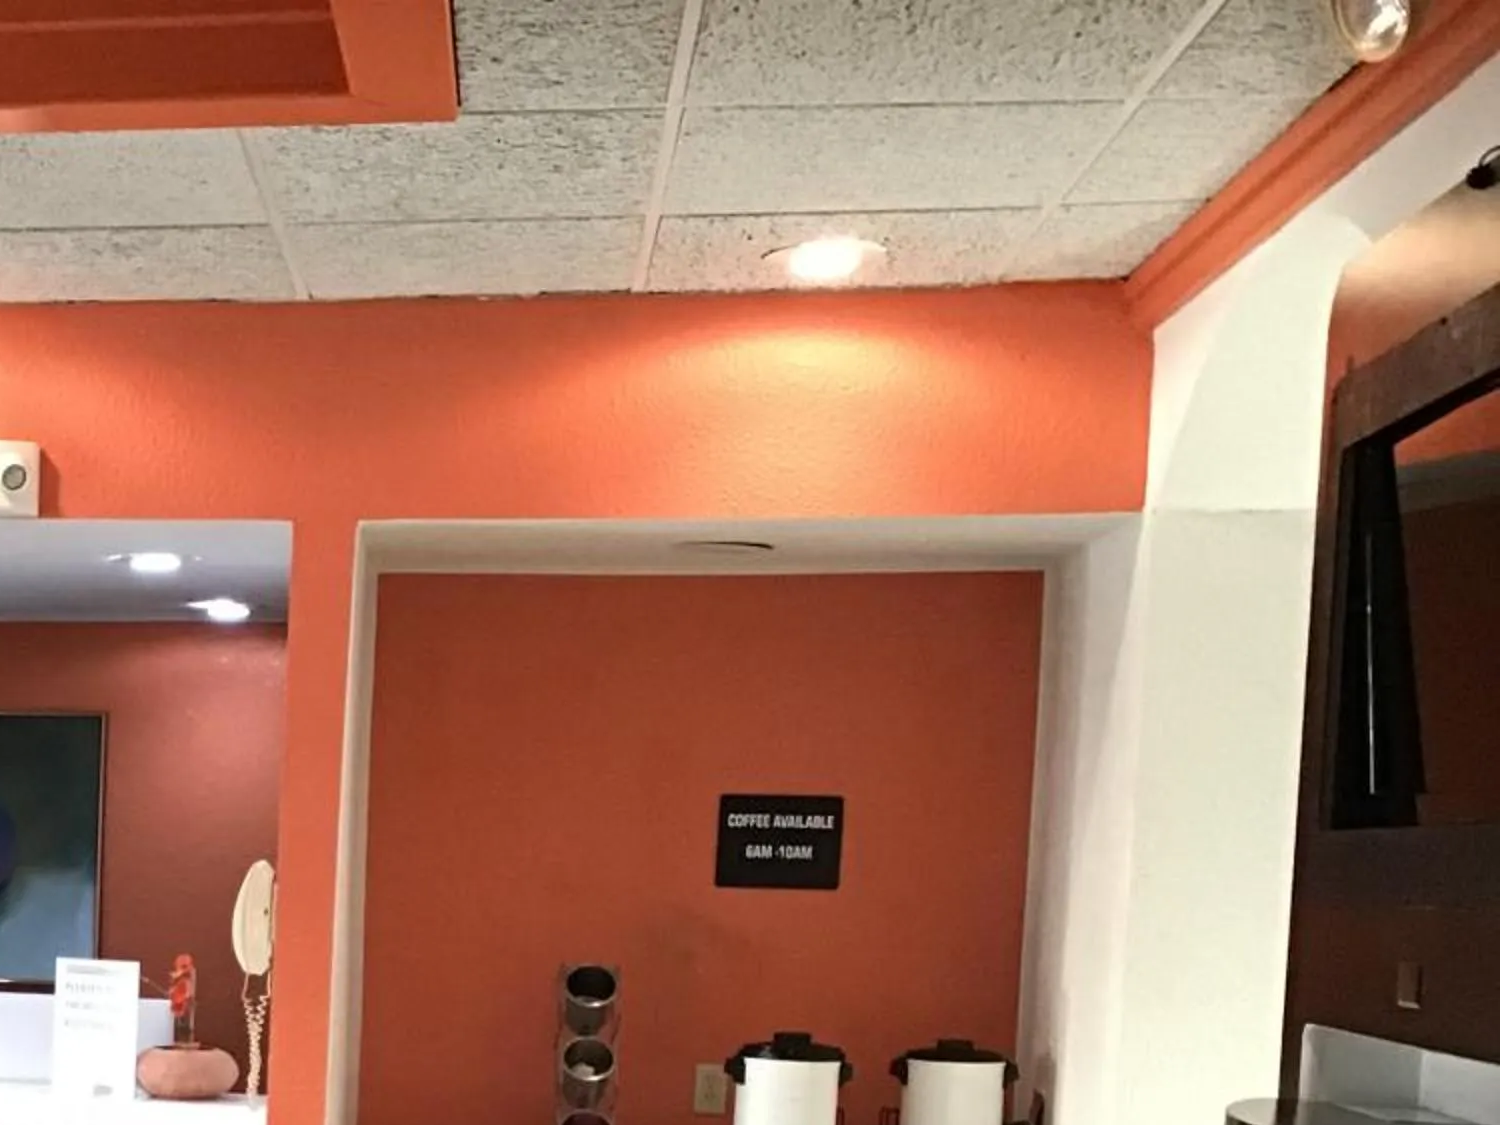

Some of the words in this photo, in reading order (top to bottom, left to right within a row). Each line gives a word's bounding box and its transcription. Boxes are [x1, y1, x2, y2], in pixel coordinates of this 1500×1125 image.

[727, 813, 771, 829] COFFEE
[773, 814, 835, 830] AVAILABLE
[745, 844, 773, 859] 6AM
